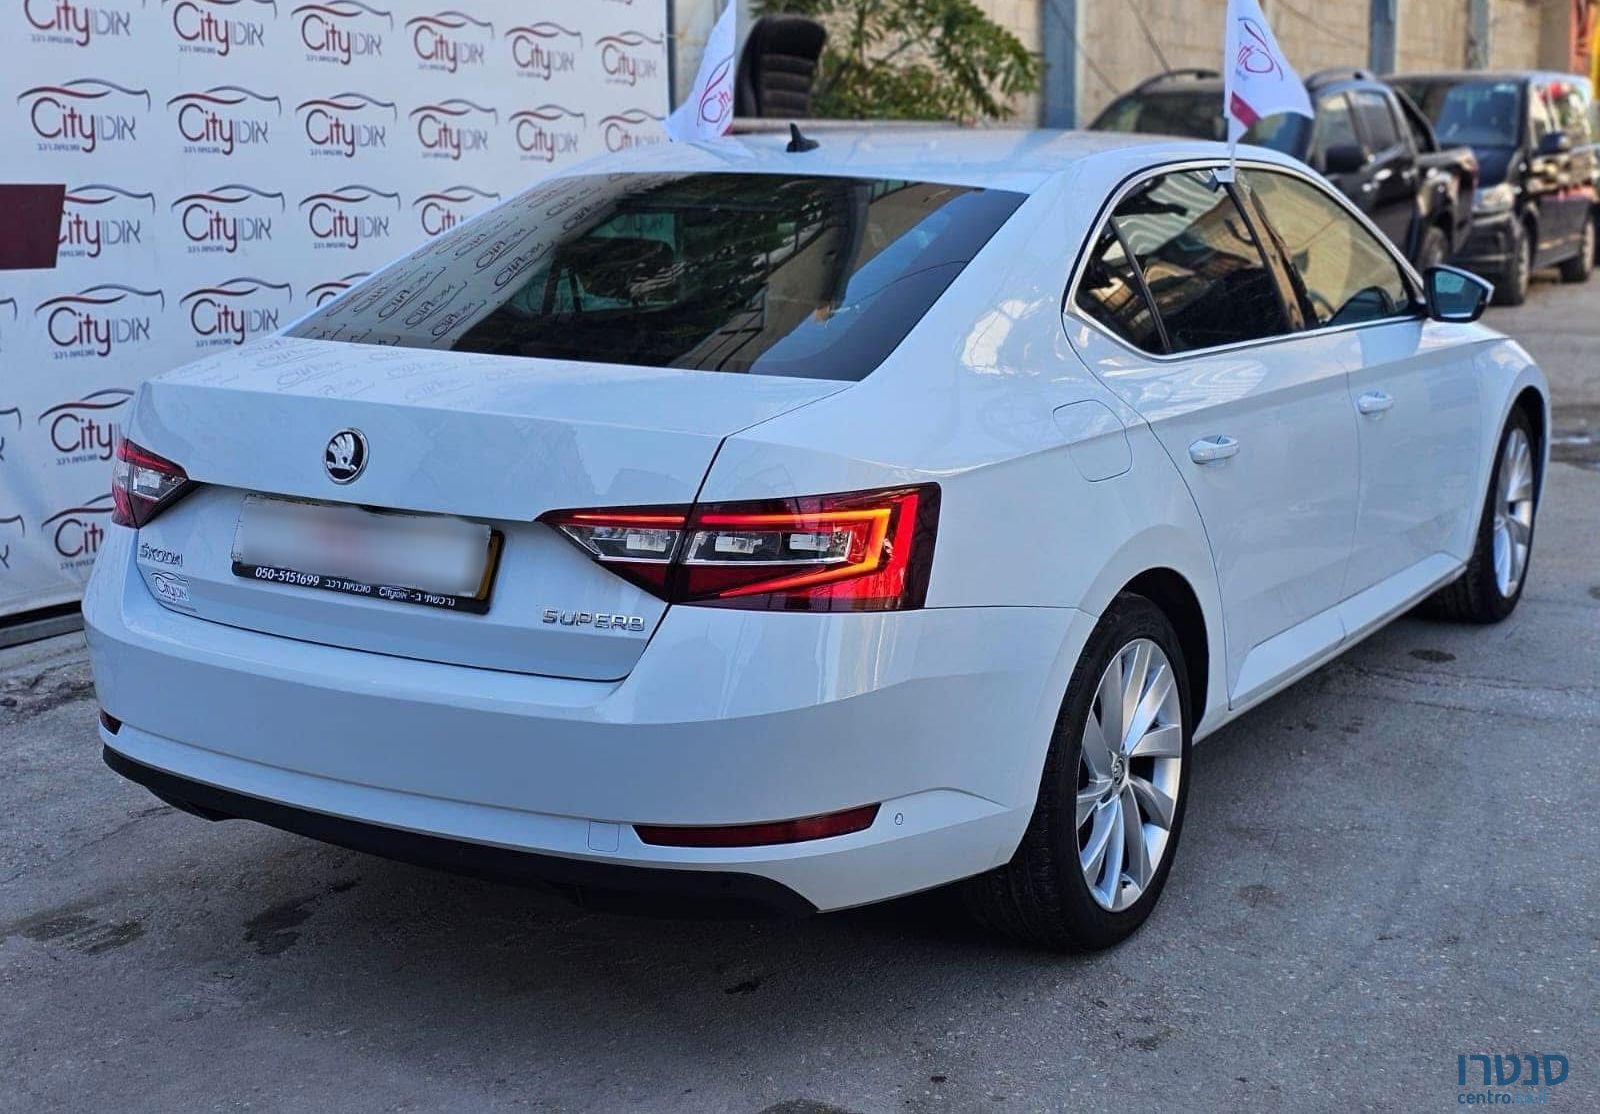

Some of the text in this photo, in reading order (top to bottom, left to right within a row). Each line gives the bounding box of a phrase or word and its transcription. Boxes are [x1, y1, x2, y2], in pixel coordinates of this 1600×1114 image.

[173, 1, 230, 56] City
[302, 13, 351, 65] City
[414, 24, 457, 74] City
[512, 35, 551, 80] City
[31, 96, 95, 153] City
[178, 103, 234, 155] City
[305, 108, 355, 158] City
[418, 114, 461, 161] City
[516, 118, 554, 163] City
[58, 210, 101, 258] ity
[182, 203, 238, 253] City
[309, 202, 358, 250] City
[48, 306, 111, 357] City
[191, 298, 245, 345] City
[51, 413, 113, 461] City
[255, 566, 320, 586] 050-5151699
[325, 579, 341, 589] רכב
[543, 608, 645, 632] SUPERB
